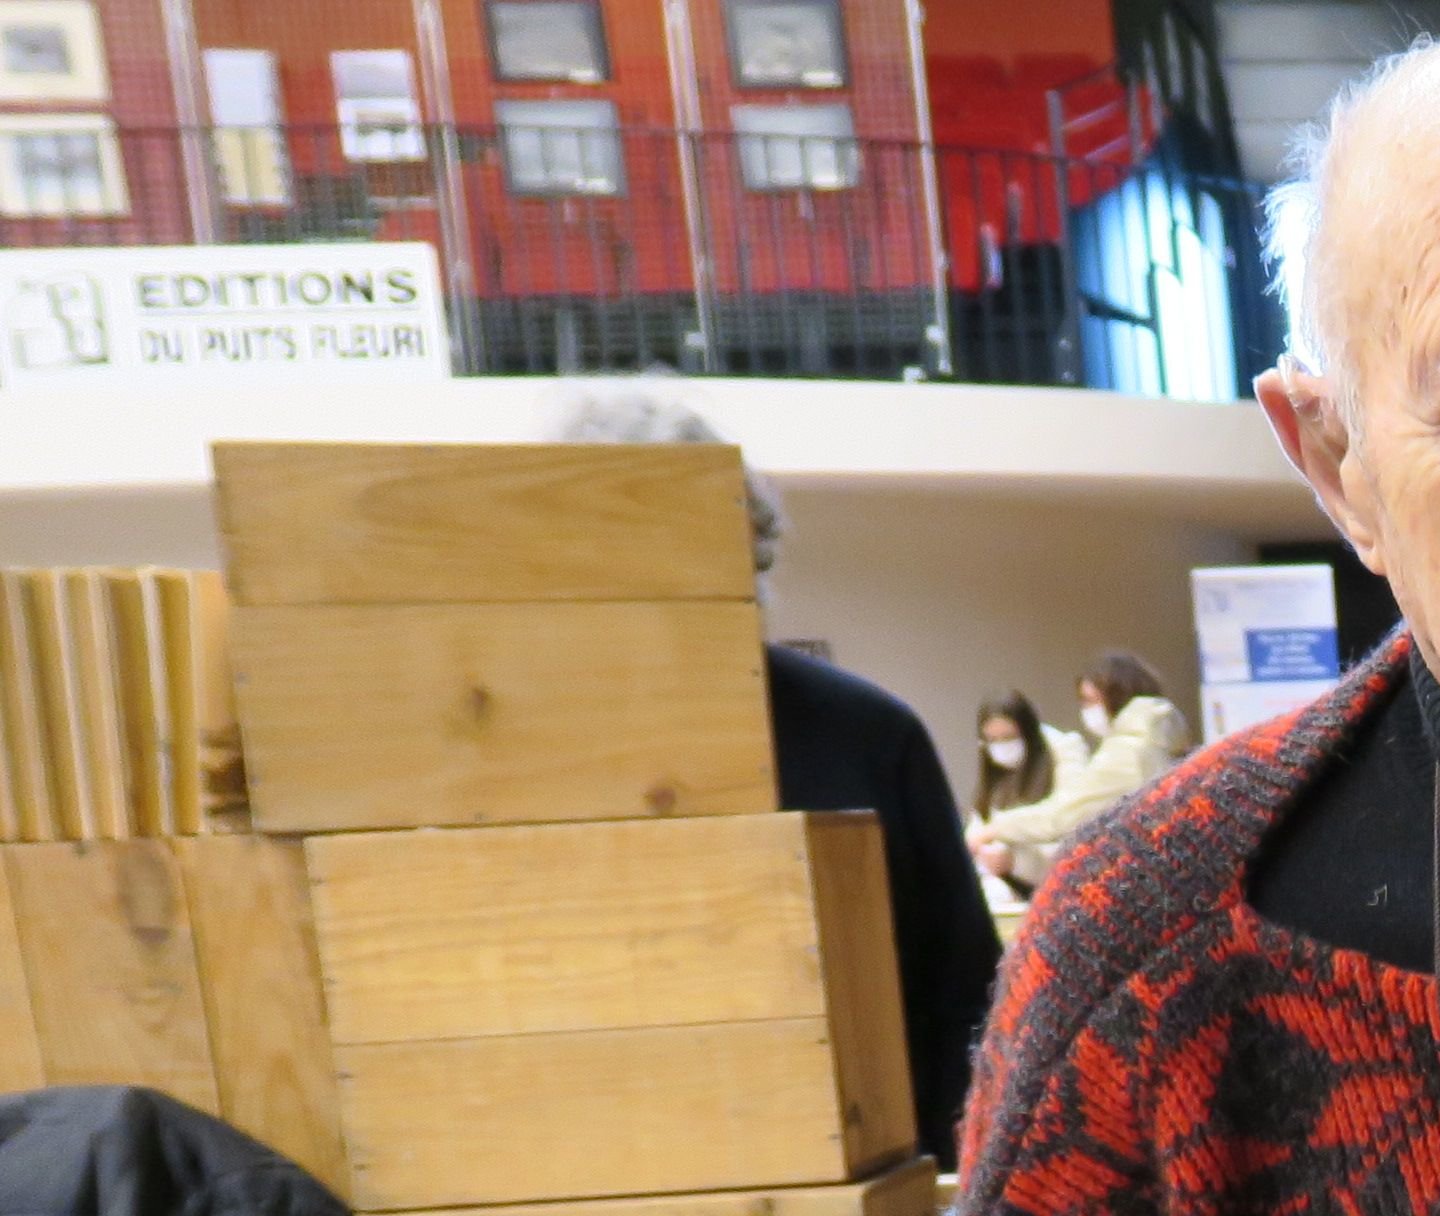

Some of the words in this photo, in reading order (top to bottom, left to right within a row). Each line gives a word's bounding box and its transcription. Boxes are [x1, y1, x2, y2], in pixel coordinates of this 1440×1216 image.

[135, 268, 419, 308] EDITIONS
[141, 329, 182, 362] DU
[206, 326, 298, 361] PUITS
[313, 323, 425, 359] FLEURI
